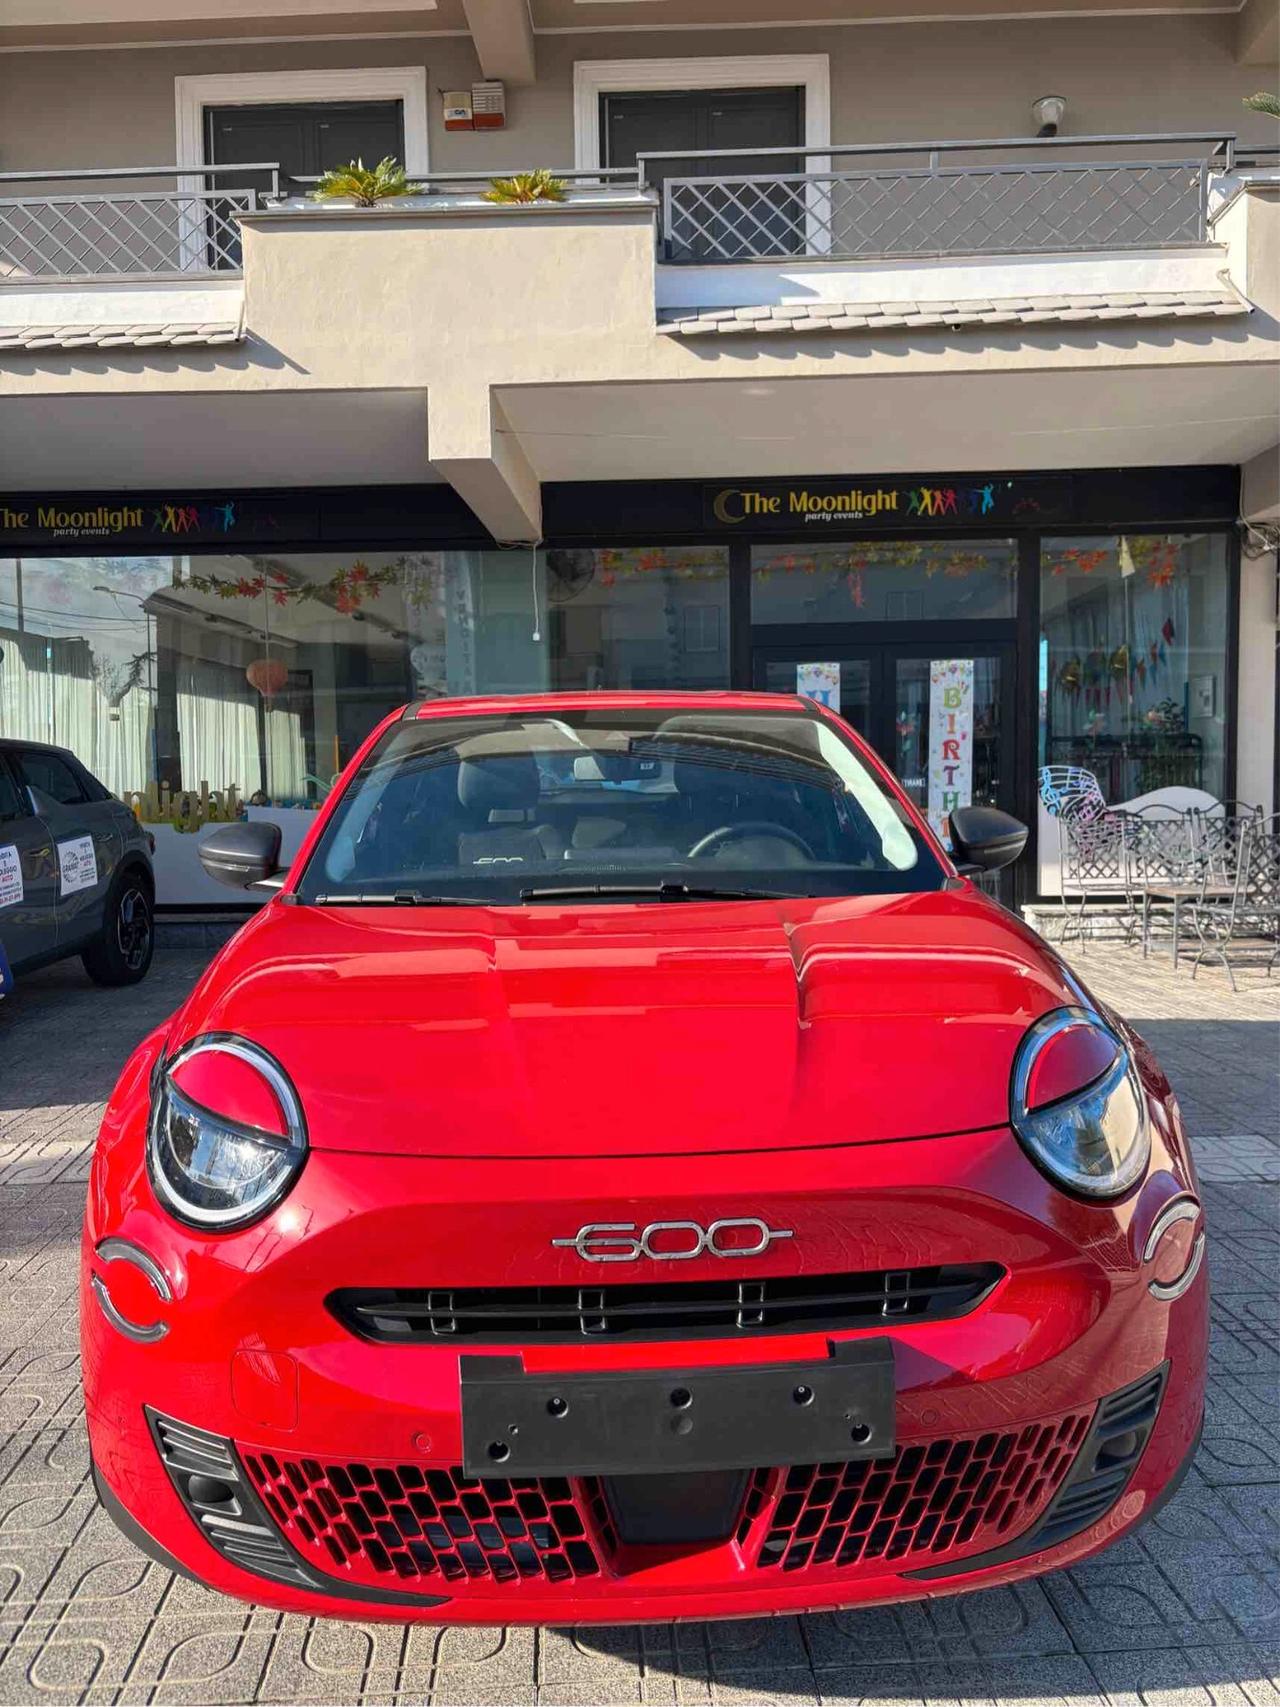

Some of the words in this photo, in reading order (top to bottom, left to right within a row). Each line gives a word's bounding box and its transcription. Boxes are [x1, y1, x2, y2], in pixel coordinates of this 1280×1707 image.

[741, 491, 780, 513] The
[790, 489, 898, 517] Moonlight
[37, 507, 144, 533] Moonlight
[804, 512, 831, 522] party
[833, 511, 863, 519] events
[54, 528, 80, 537] party
[81, 527, 110, 535] events
[576, 1217, 770, 1262] 600
